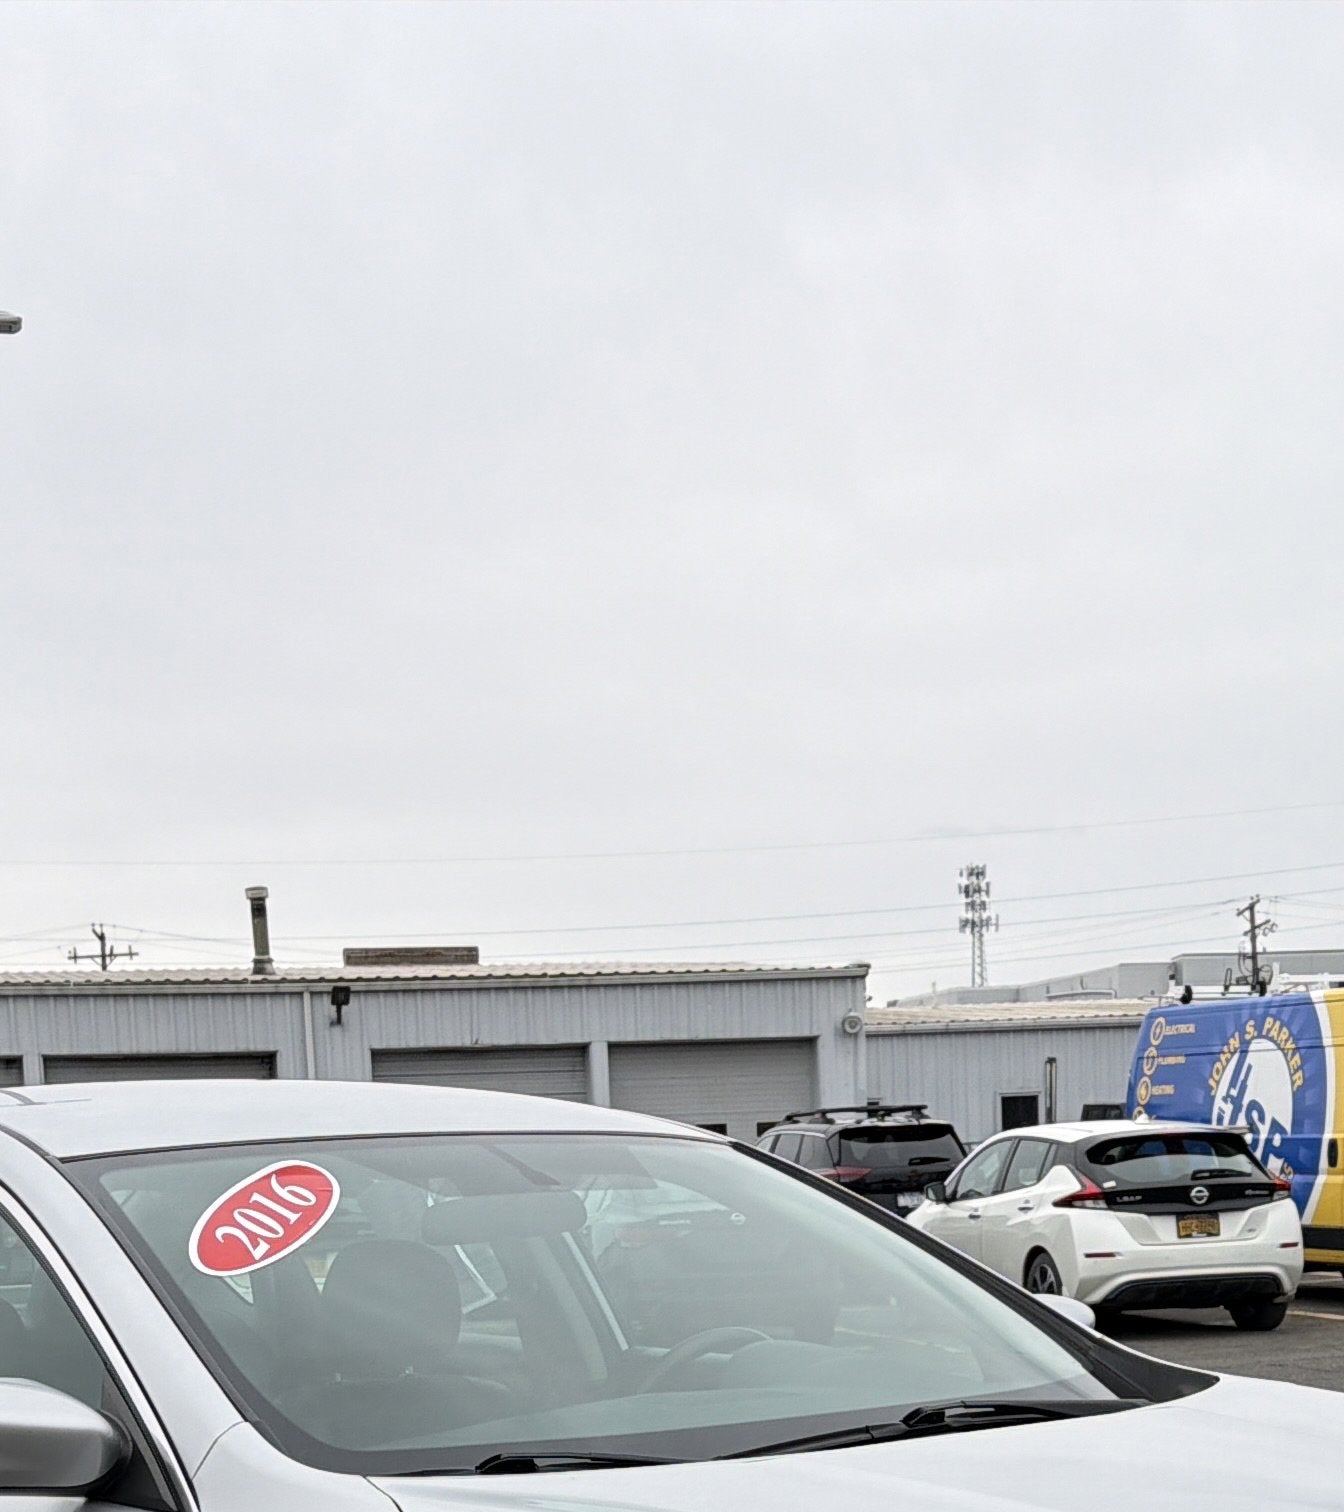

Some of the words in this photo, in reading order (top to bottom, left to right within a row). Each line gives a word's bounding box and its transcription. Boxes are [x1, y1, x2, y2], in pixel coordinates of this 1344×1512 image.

[1164, 1024, 1196, 1035] ELECTRICAL
[1208, 1031, 1241, 1096] JOHN
[1244, 1019, 1258, 1040] S.
[1263, 1016, 1305, 1092] PARKER
[214, 1173, 318, 1261] 2016
